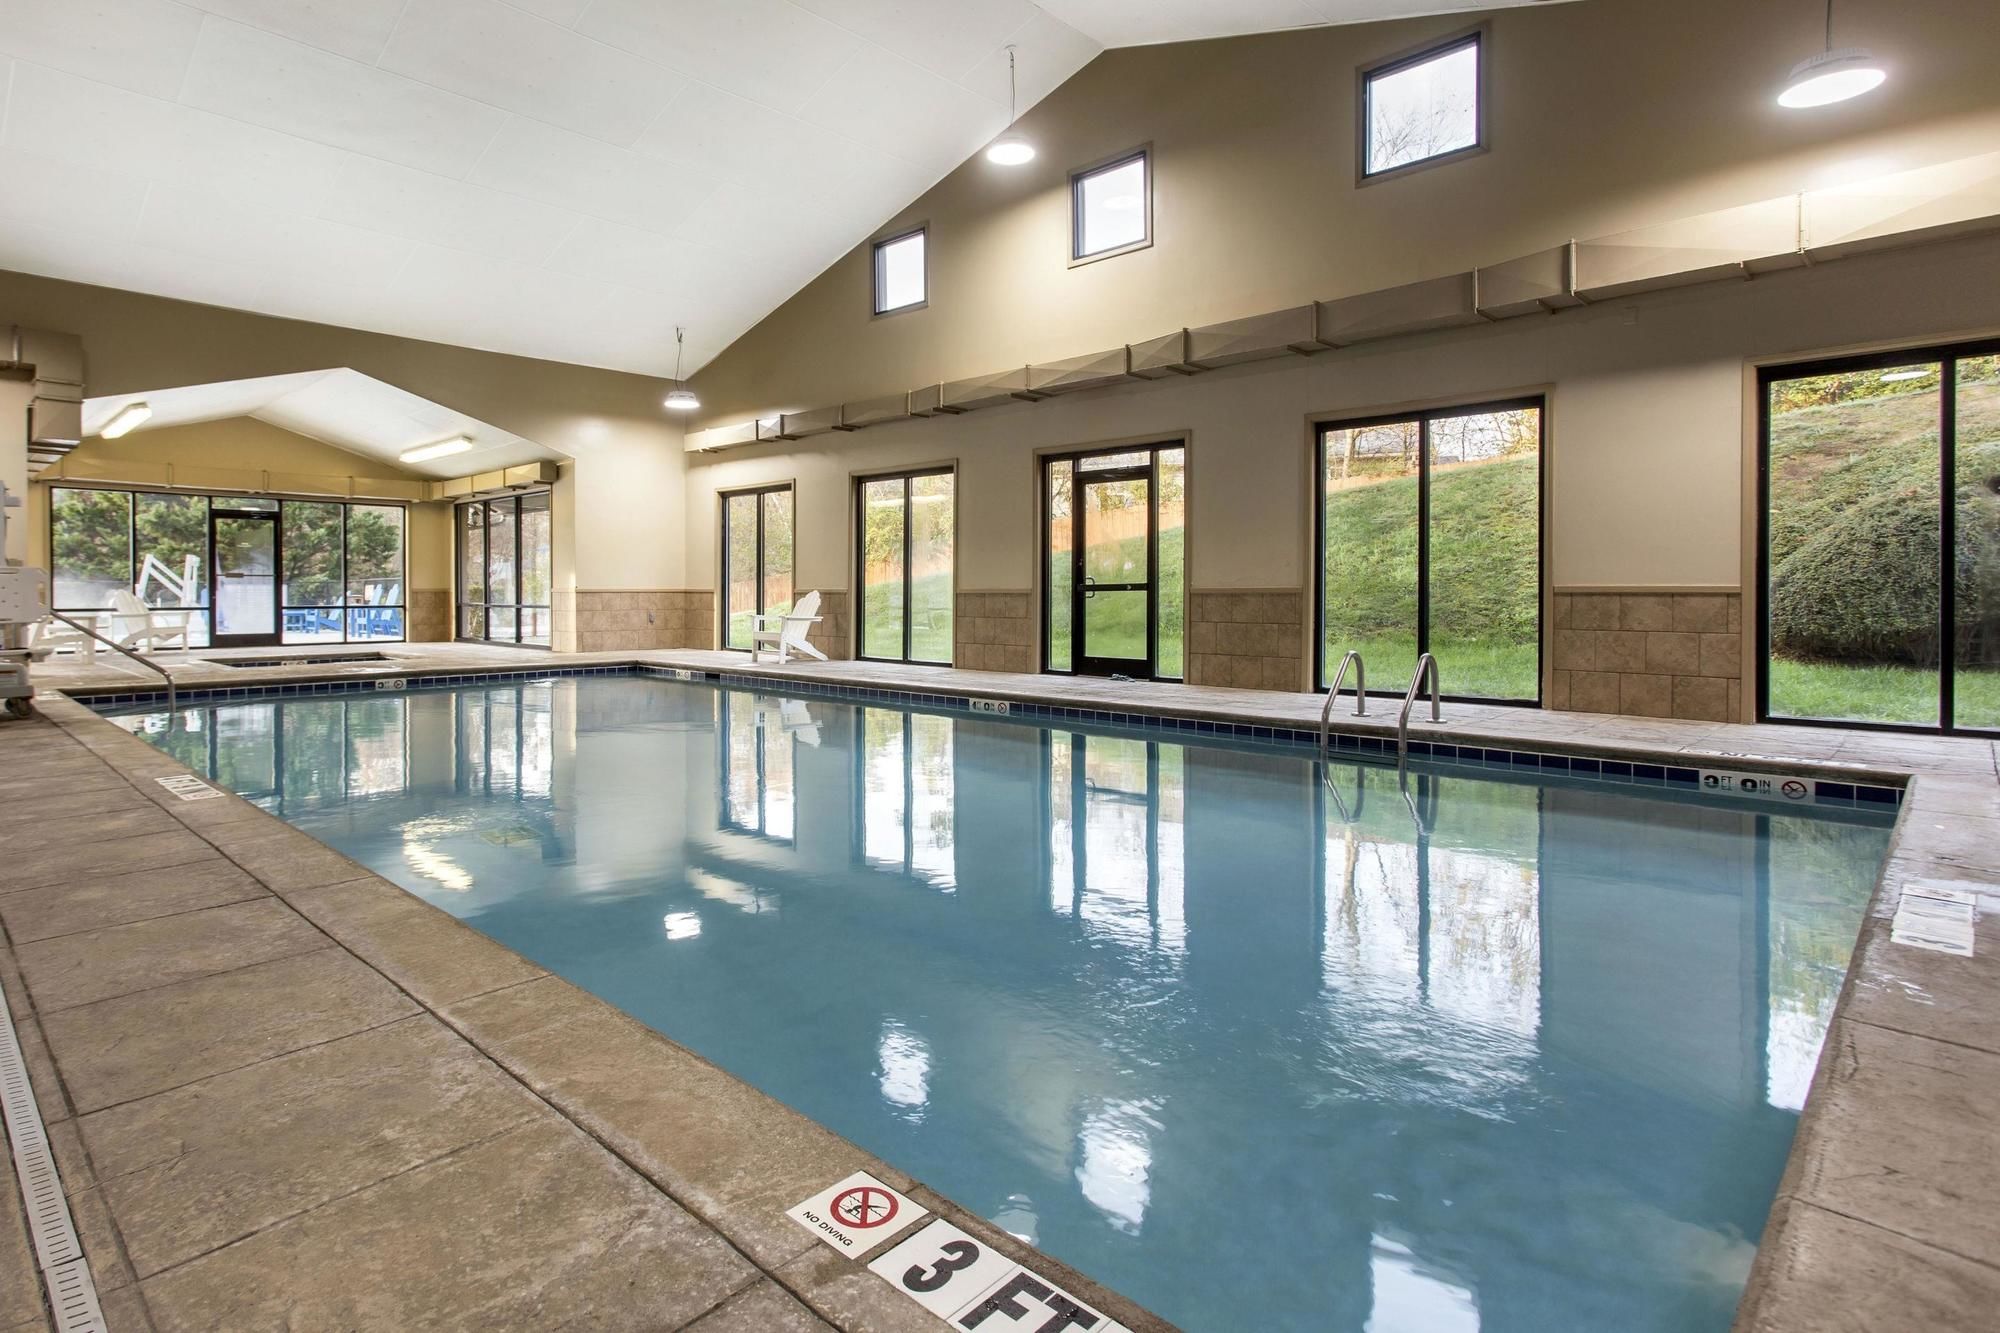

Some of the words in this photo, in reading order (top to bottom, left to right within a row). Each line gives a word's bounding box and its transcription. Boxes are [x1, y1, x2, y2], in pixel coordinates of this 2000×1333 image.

[802, 1211, 820, 1223] NO
[818, 1222, 853, 1247] DIVING
[902, 1240, 980, 1293] 3
[957, 1271, 1101, 1333] FT
